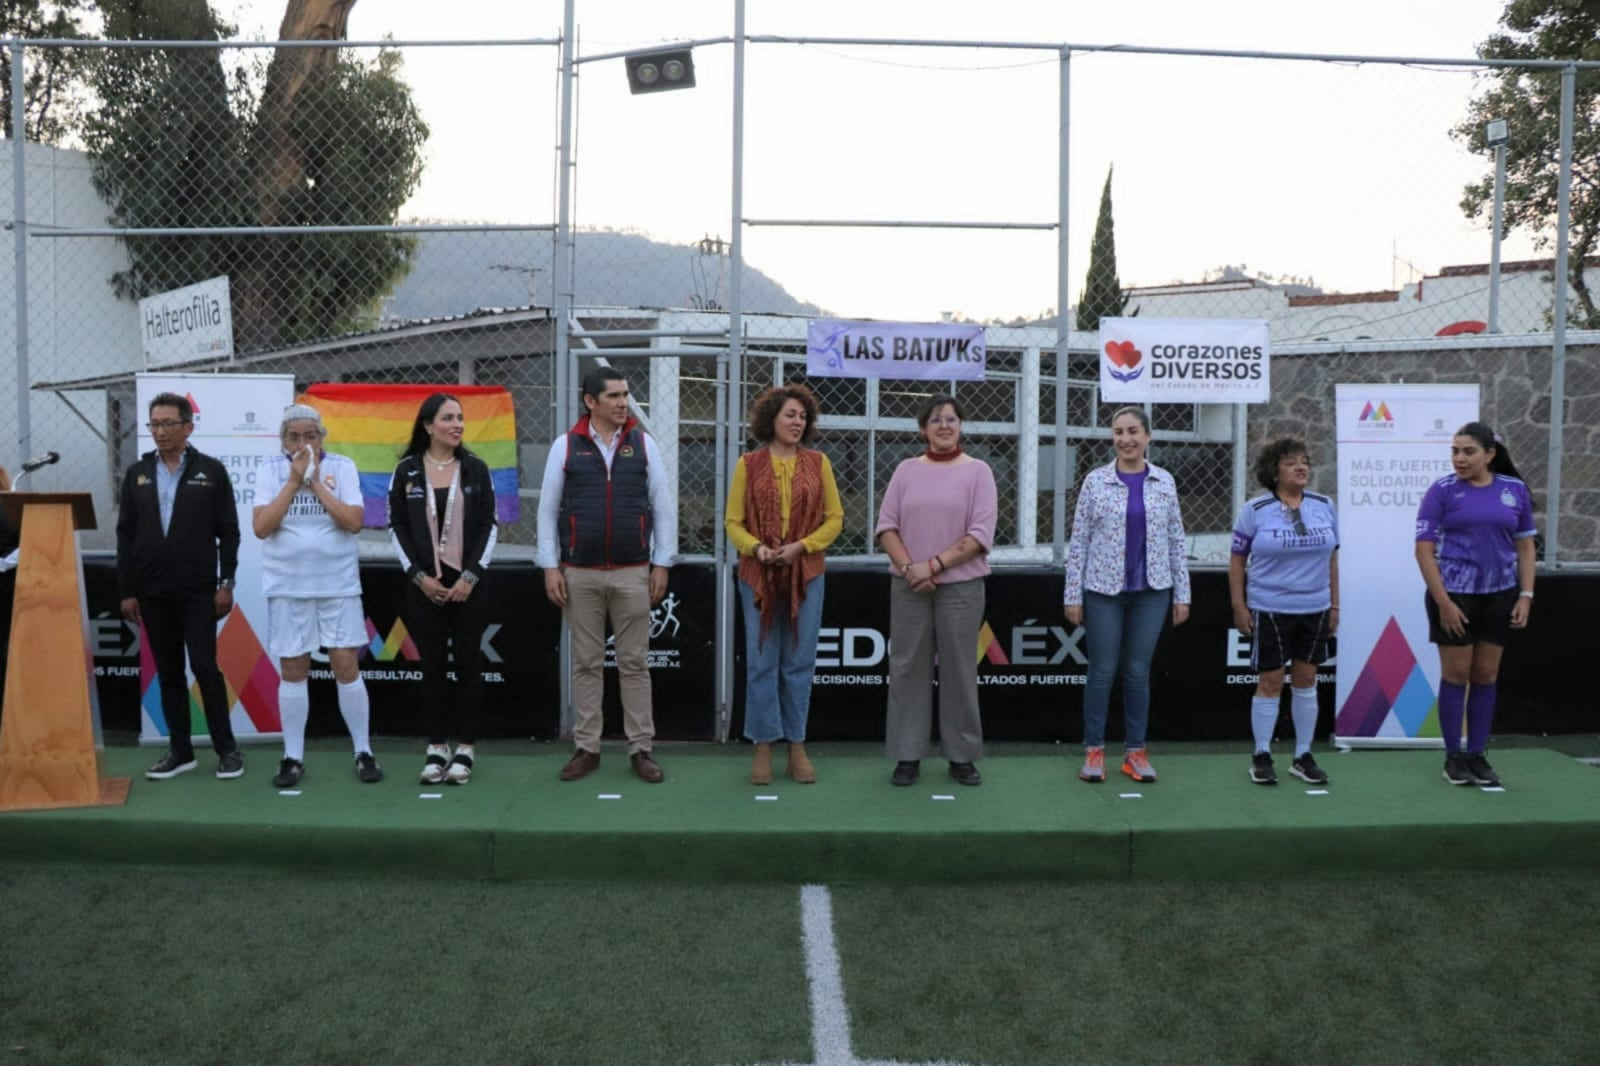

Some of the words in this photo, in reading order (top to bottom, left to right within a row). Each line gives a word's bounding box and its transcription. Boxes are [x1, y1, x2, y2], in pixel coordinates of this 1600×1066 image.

[145, 294, 221, 340] Halterofilia
[843, 335, 885, 361] LAS
[1151, 344, 1263, 361] corazones
[1151, 362, 1263, 380] DIVERSOS
[1350, 475, 1430, 487] SOLIDARIO
[1351, 492, 1372, 506] LA
[813, 675, 882, 685] ECISIONES
[976, 675, 1027, 685] LTADOS
